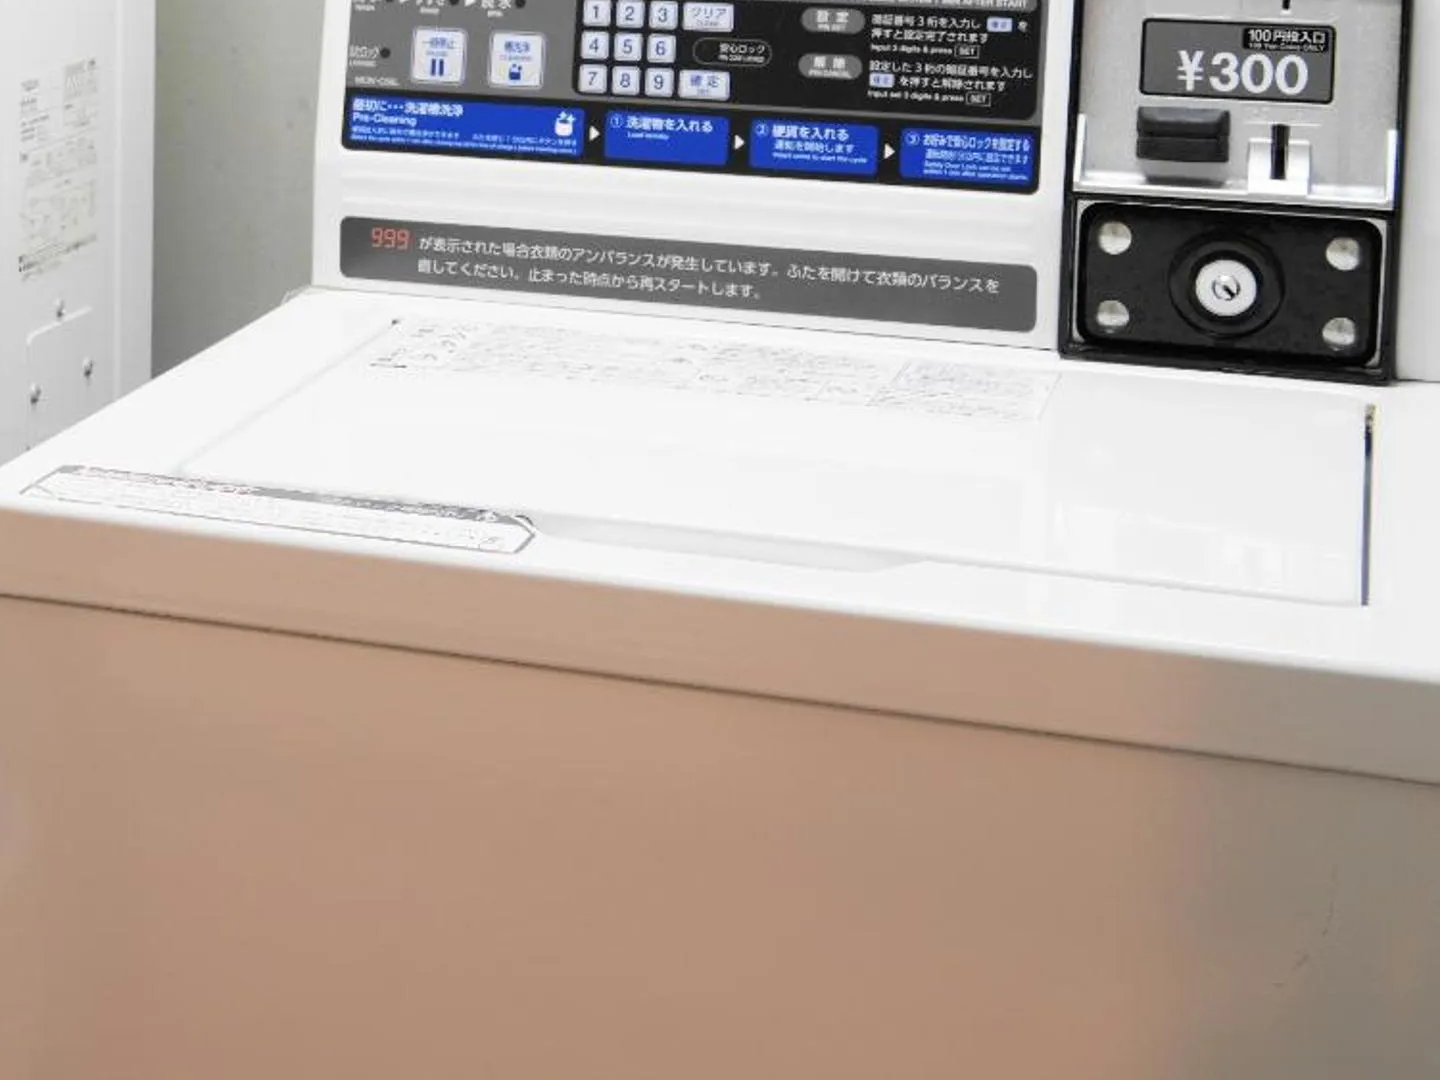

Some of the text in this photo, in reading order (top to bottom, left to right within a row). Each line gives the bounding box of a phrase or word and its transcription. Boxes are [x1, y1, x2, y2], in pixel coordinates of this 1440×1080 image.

[592, 6, 600, 18] 1
[625, 7, 634, 20] 2
[658, 8, 667, 22] 3
[589, 39, 598, 52] 4
[623, 39, 632, 53] 5
[656, 41, 665, 56] 6
[588, 71, 598, 85] 7
[1176, 50, 1309, 95] ¥300
[620, 73, 630, 87] 8
[654, 75, 664, 90] 9
[371, 227, 410, 250] 999
